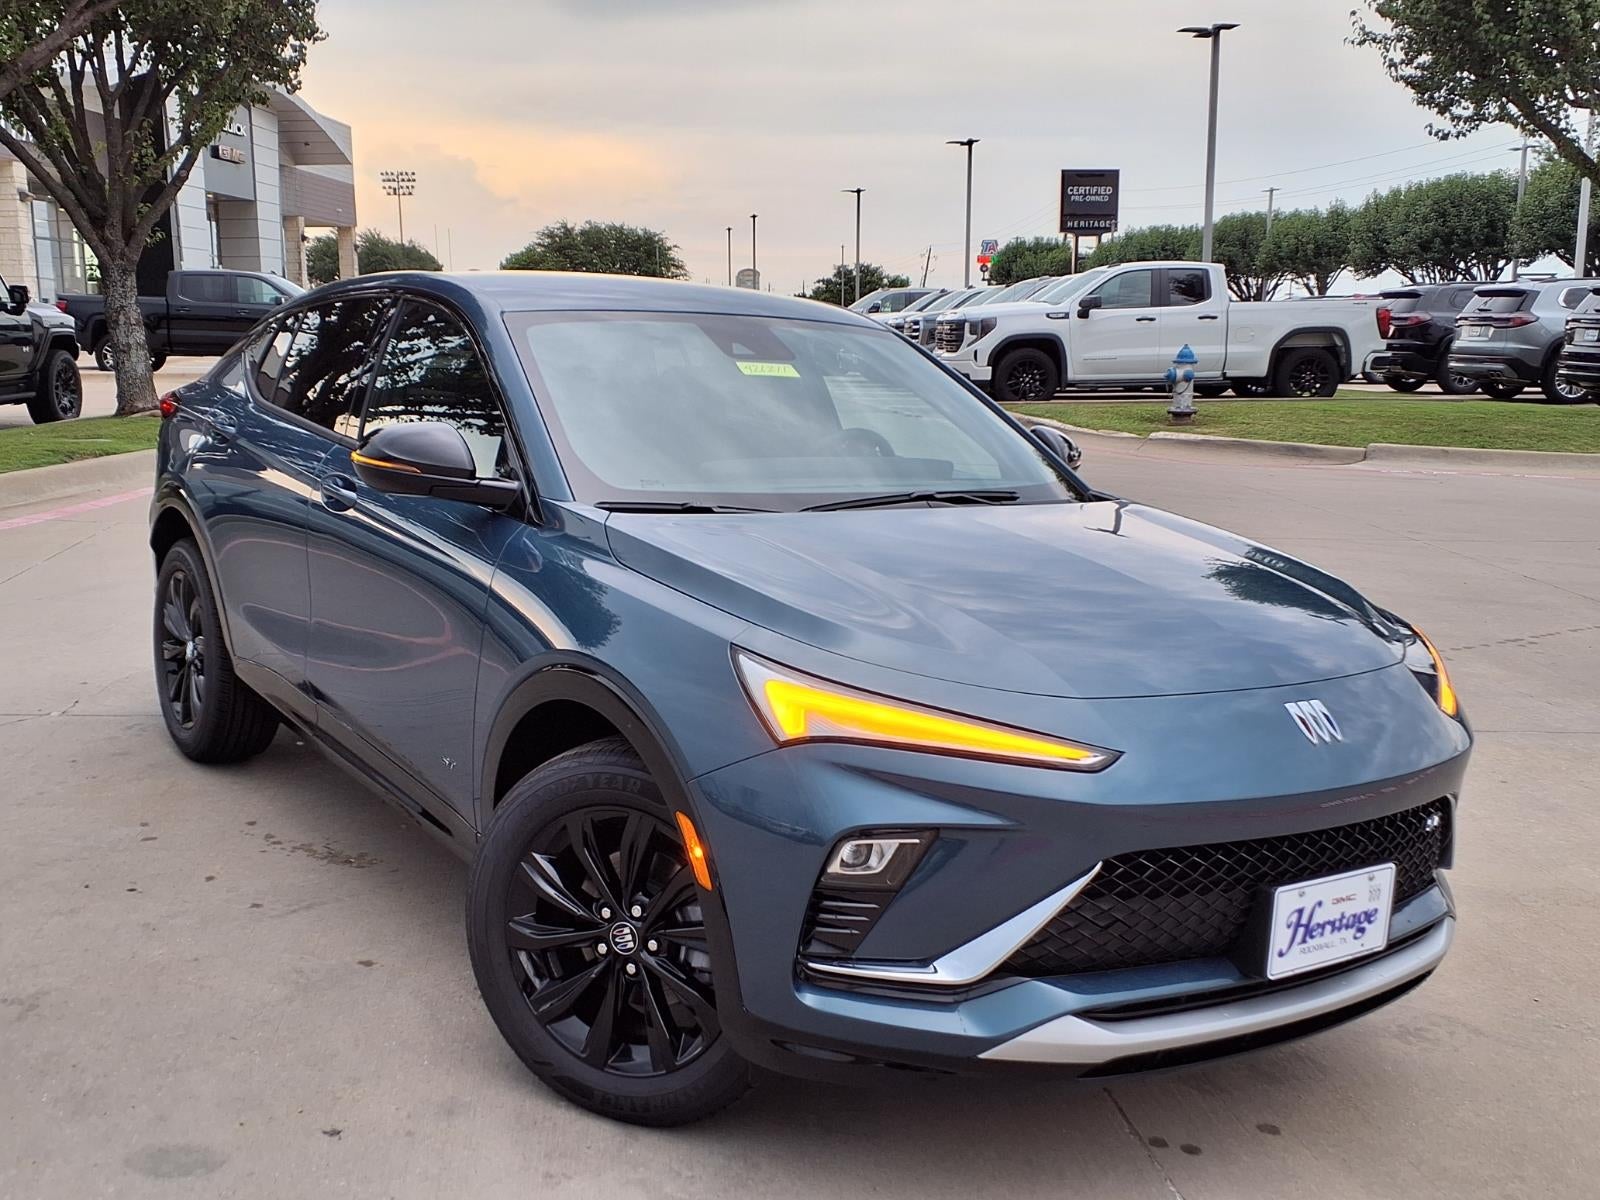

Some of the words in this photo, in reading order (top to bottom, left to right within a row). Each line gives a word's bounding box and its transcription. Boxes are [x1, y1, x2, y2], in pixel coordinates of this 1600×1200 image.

[223, 119, 247, 137] UICK
[1067, 186, 1113, 195] CERTIFIED
[1067, 220, 1111, 228] HERITAGE
[1277, 900, 1379, 958] Heritage
